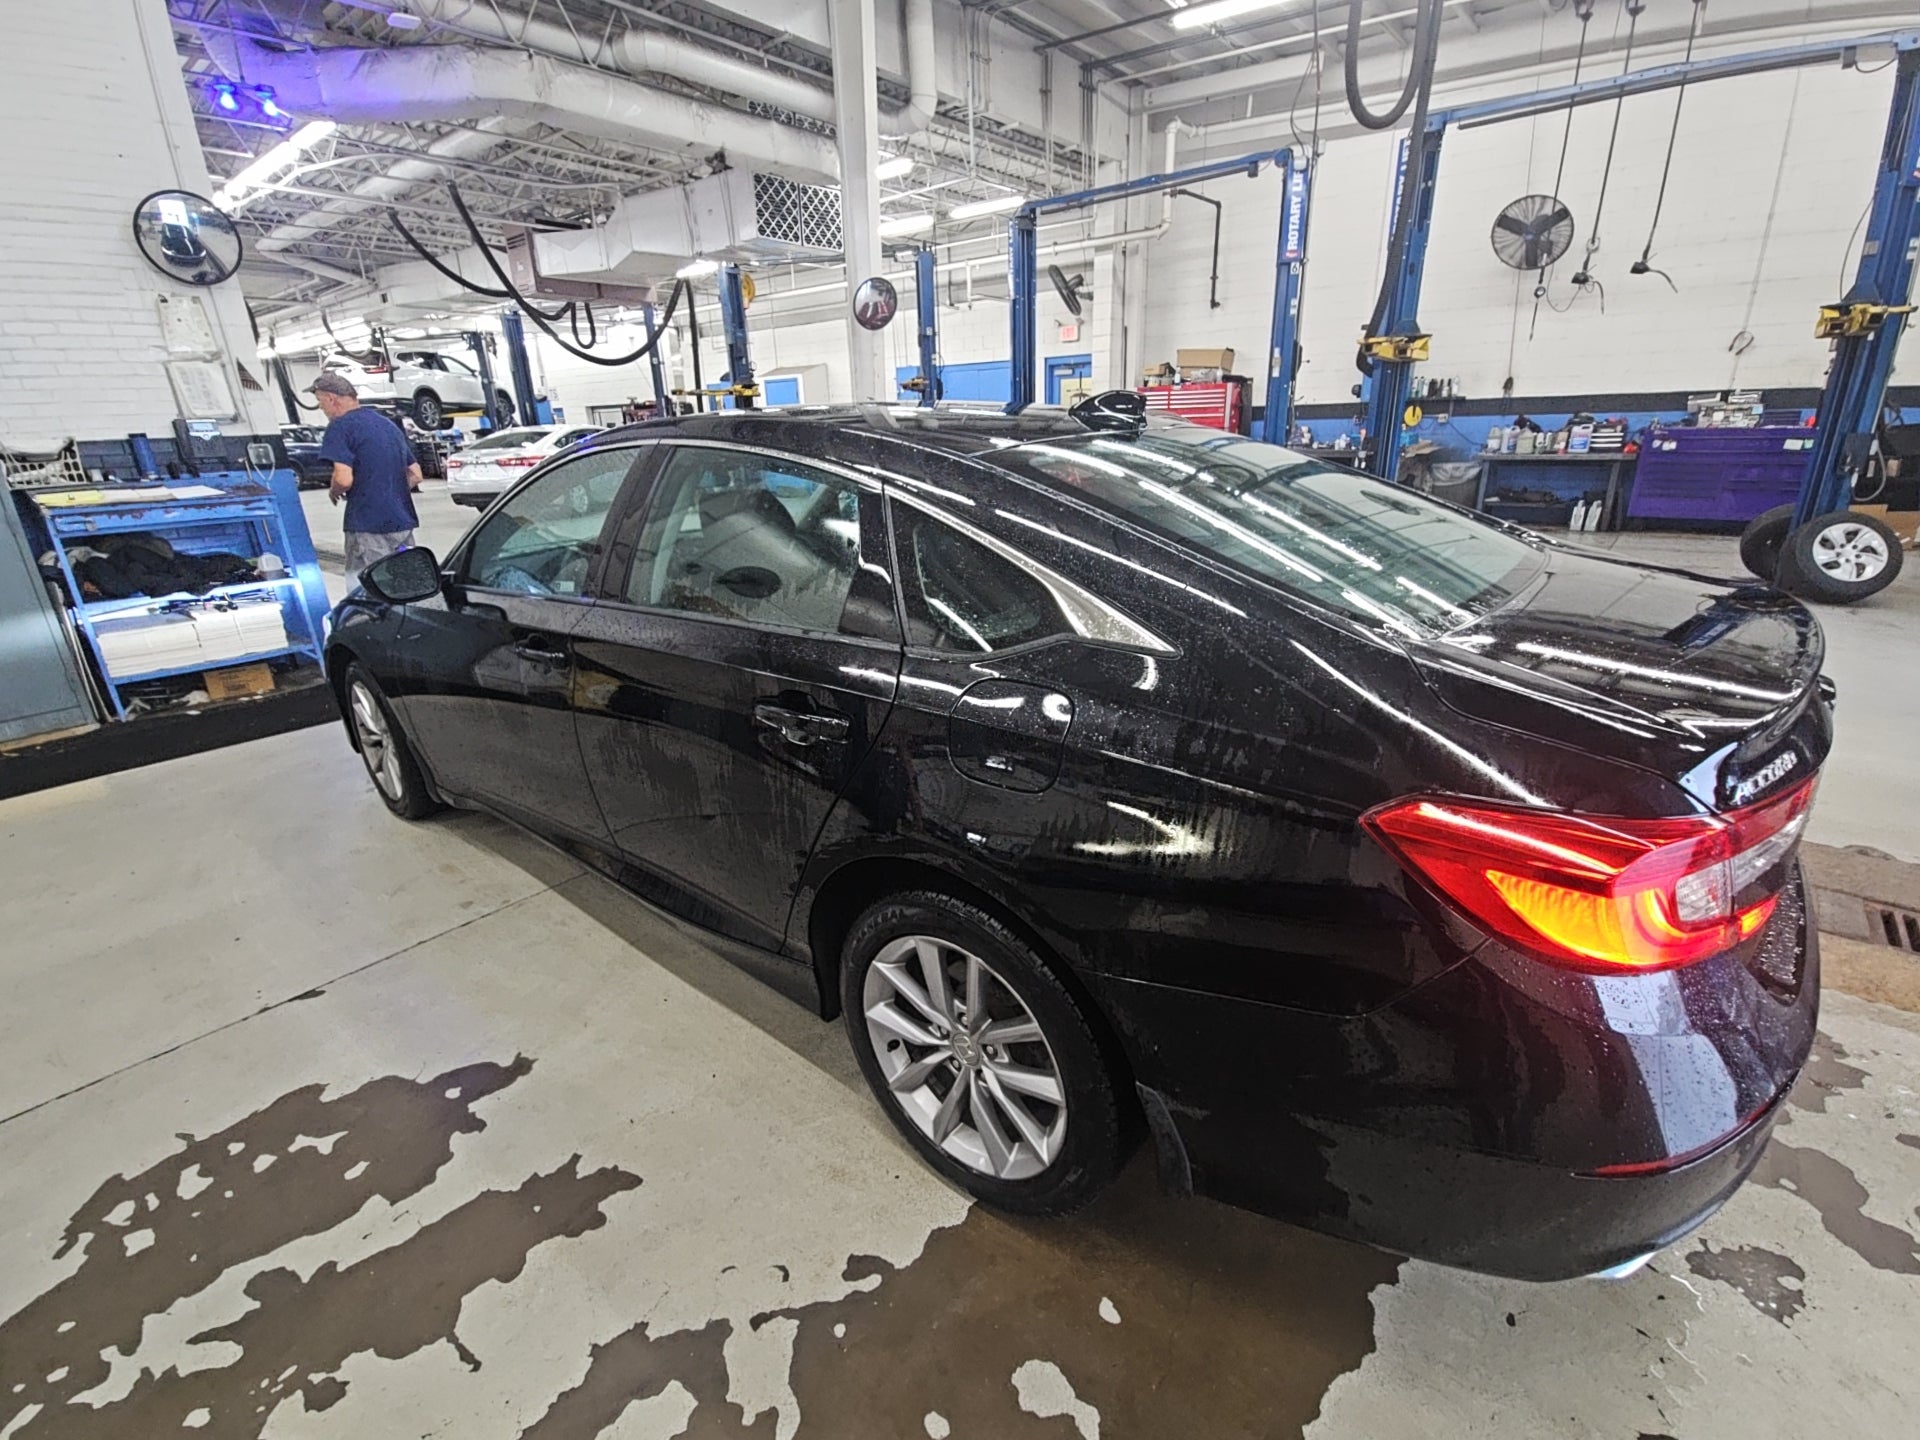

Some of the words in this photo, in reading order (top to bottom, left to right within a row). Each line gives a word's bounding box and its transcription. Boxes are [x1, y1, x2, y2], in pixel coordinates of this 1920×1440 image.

[1292, 171, 1303, 192] LIF
[1287, 195, 1302, 250] ROTARY
[1291, 263, 1298, 273] 6
